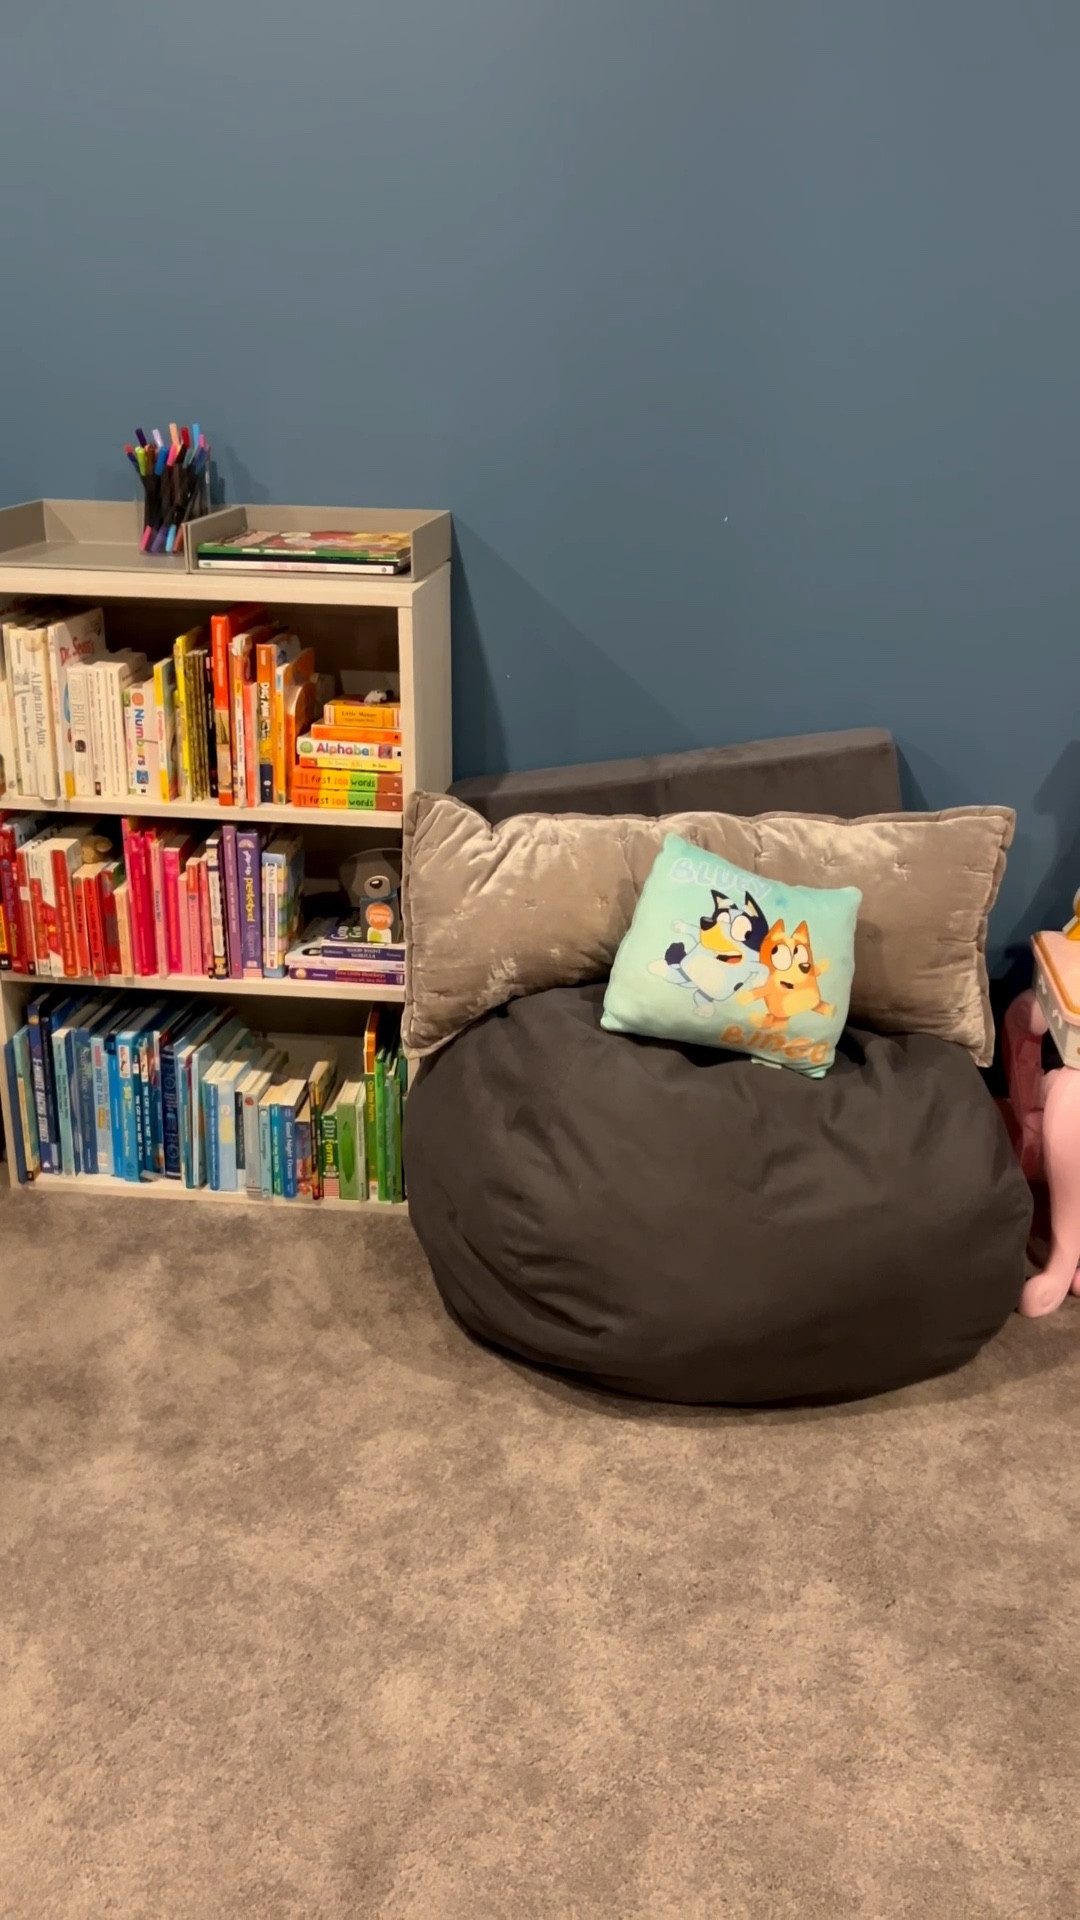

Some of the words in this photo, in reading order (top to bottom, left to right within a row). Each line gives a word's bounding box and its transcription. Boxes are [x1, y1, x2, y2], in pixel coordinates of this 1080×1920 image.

[72, 636, 94, 655] Seuss
[31, 680, 44, 701] Light
[35, 712, 45, 727] the
[36, 727, 47, 747] Attic
[134, 709, 146, 766] Numbers
[316, 742, 374, 756] Alphabet
[311, 774, 331, 784] first
[334, 777, 348, 786] 100
[350, 776, 375, 787] words
[309, 796, 328, 804] first
[332, 798, 346, 806] 100
[349, 797, 374, 807] words
[671, 857, 772, 900] BLUEY
[33, 1058, 44, 1090] 5-MINUTE
[368, 1081, 374, 1090] On
[36, 1091, 47, 1115] RACING
[38, 1116, 49, 1143] STORIES
[285, 1139, 293, 1157] Night
[326, 1139, 335, 1163] Farm
